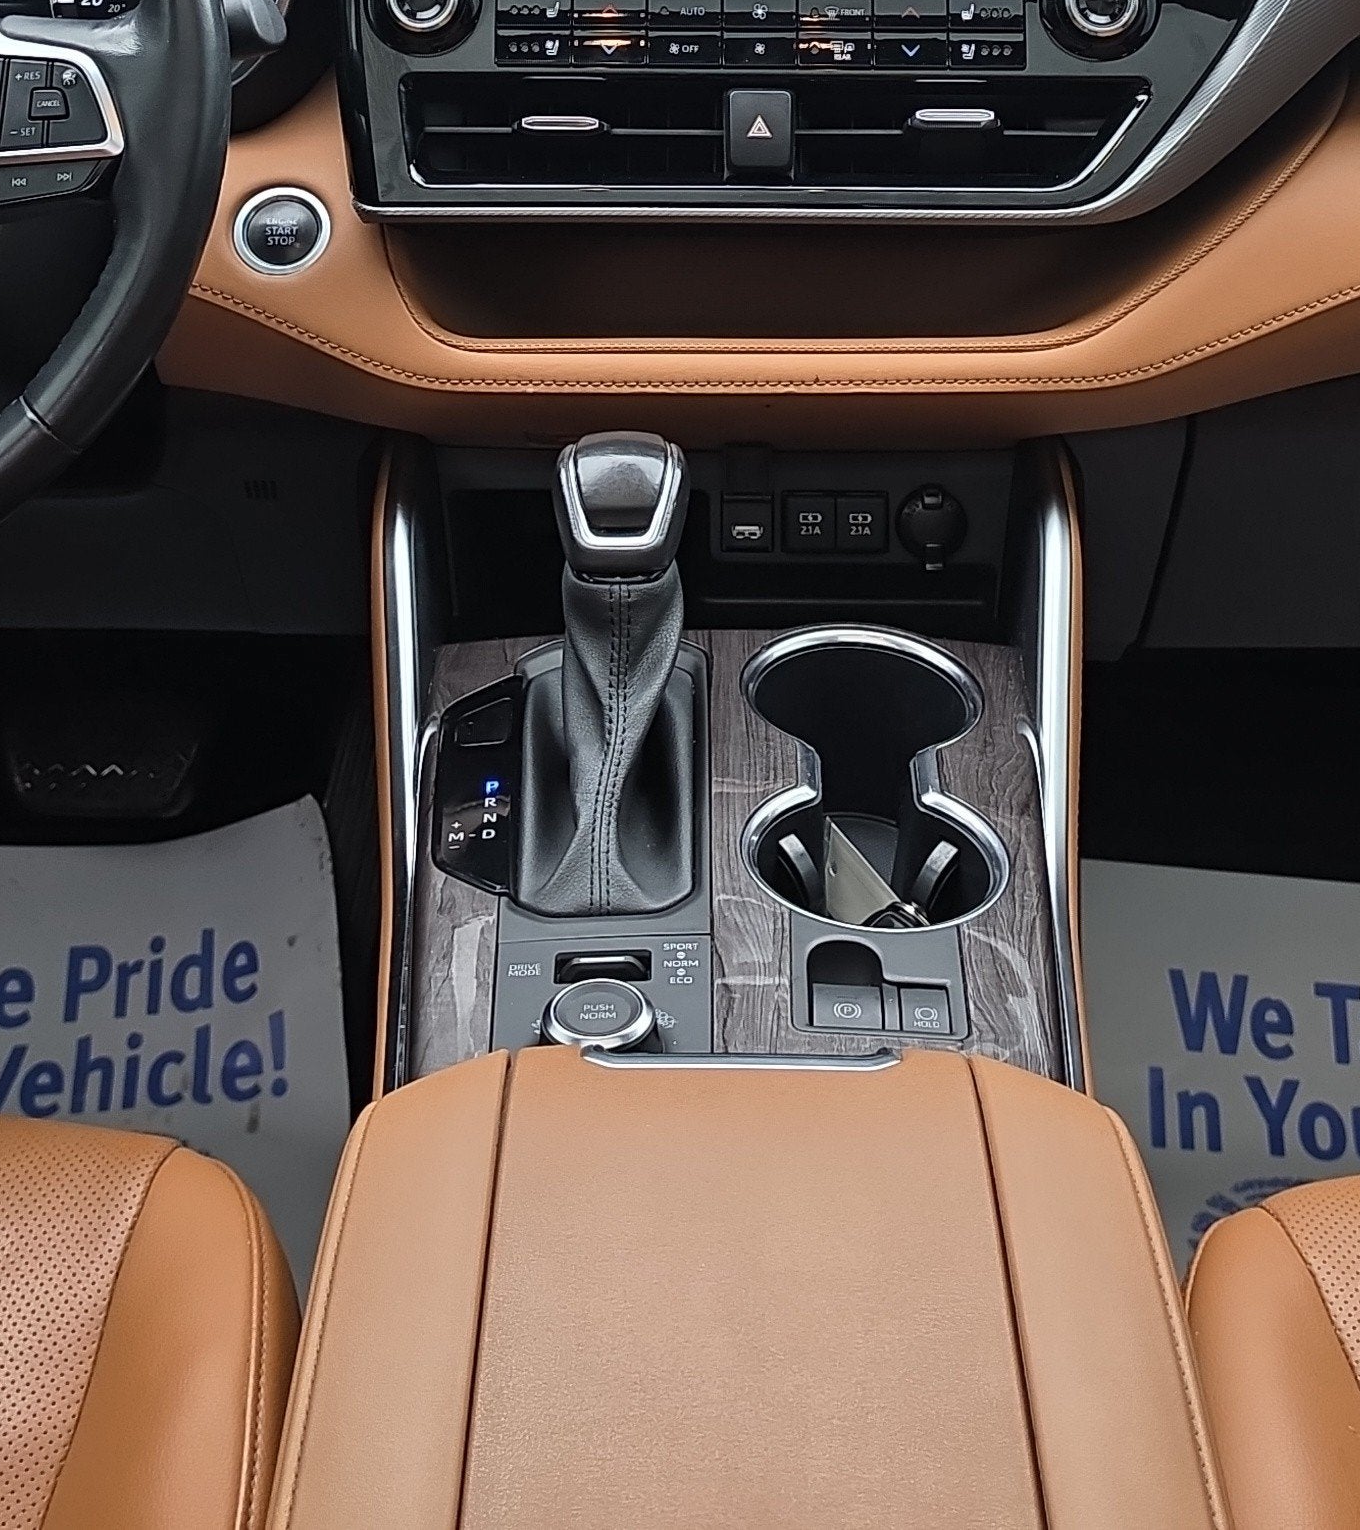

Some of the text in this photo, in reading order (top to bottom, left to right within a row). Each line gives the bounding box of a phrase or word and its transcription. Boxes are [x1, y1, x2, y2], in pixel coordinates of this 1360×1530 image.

[107, 4, 121, 13] 20
[680, 7, 705, 16] AUTO
[840, 8, 865, 17] FRONT
[682, 44, 700, 53] OFF
[36, 99, 61, 108] CANCEL
[265, 225, 299, 236] START
[267, 236, 296, 246] STOP
[486, 780, 499, 794] P
[484, 797, 497, 808] R
[483, 813, 497, 823] N
[448, 828, 495, 842] M D
[663, 942, 699, 951] SPORT
[509, 962, 541, 972] DRIVE
[663, 959, 699, 968] NORM
[62, 926, 261, 1025] Pride
[508, 968, 541, 977] MODE
[669, 975, 693, 984] ECO
[583, 1003, 614, 1012] PUSH
[580, 1011, 618, 1021] NORM
[1167, 967, 1295, 1061] We
[913, 1019, 940, 1029] HOLD
[1146, 1065, 1223, 1153] In
